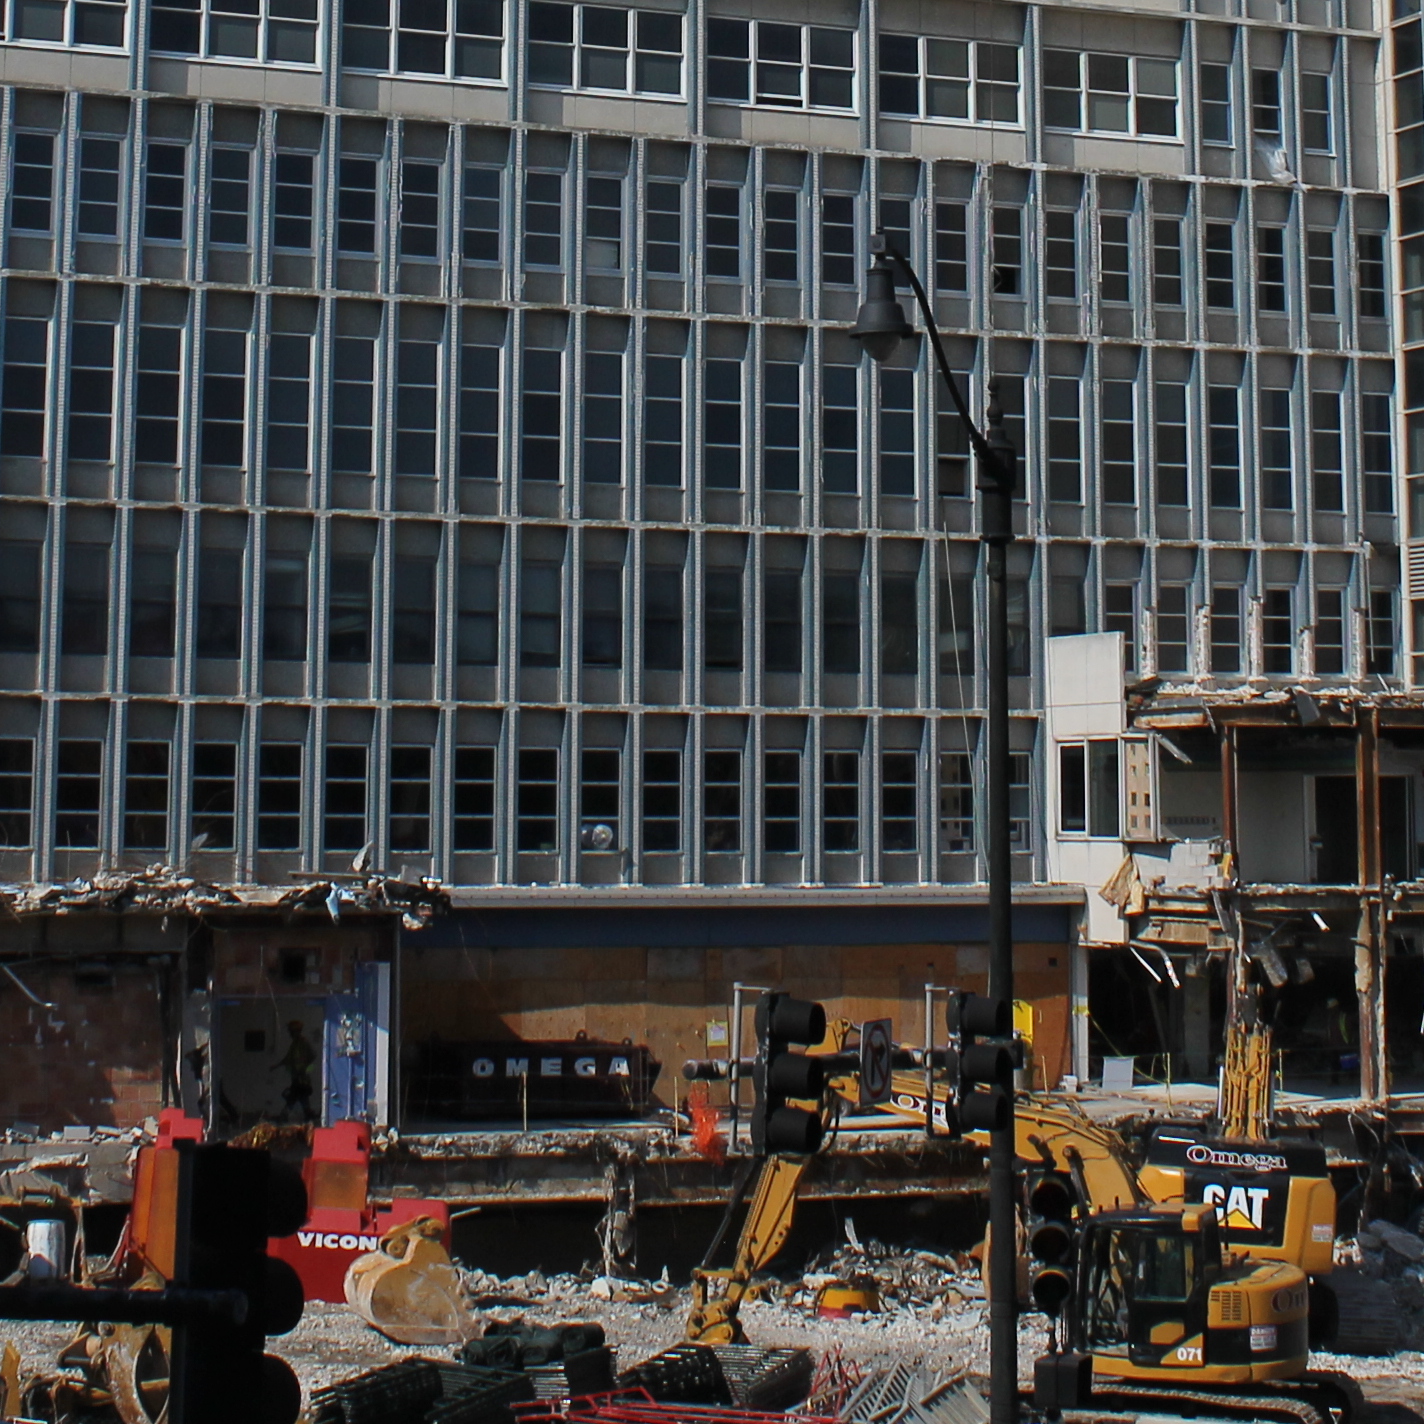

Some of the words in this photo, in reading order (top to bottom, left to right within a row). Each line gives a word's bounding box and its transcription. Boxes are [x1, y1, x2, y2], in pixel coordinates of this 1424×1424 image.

[472, 1057, 630, 1077] OMEGA
[1186, 1145, 1287, 1171] Omega
[1203, 1183, 1269, 1230] CAT
[297, 1231, 377, 1251] VICON
[1177, 1347, 1202, 1361] 071
